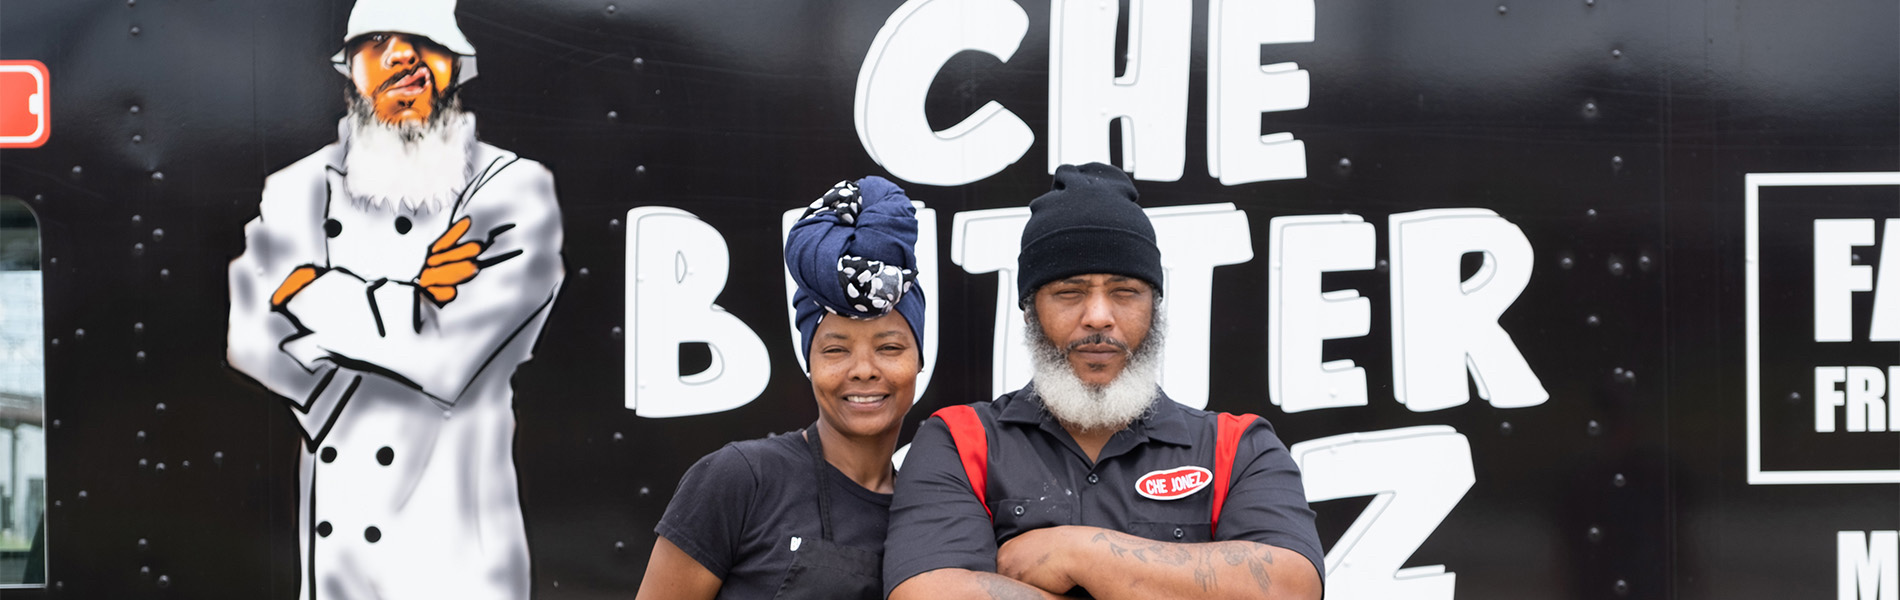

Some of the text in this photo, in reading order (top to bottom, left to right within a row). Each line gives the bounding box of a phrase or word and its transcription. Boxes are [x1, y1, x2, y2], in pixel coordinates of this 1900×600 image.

[854, 0, 1316, 186] CHE
[1145, 471, 1204, 495] CHE JONEZ
